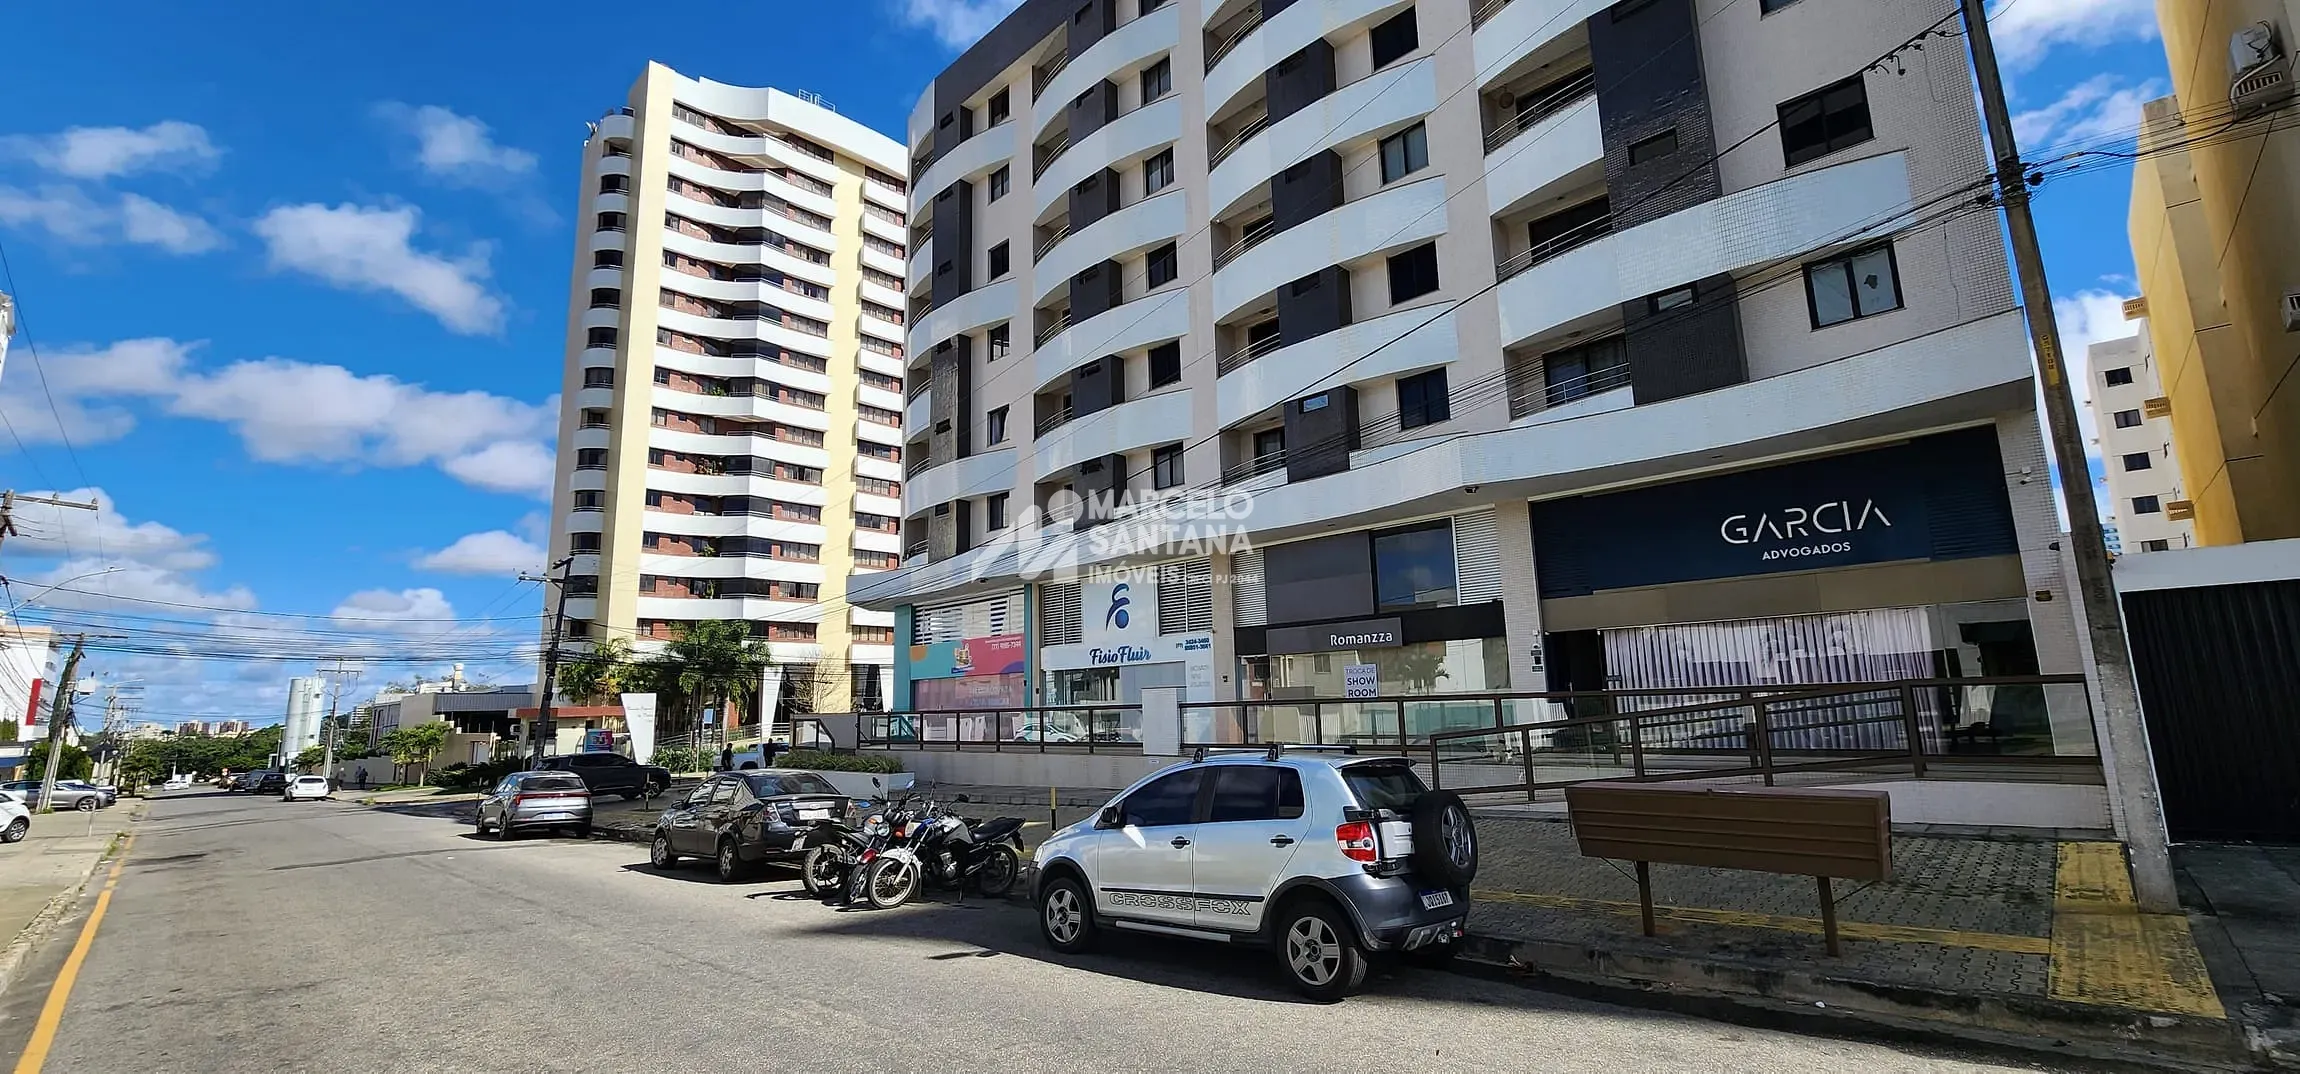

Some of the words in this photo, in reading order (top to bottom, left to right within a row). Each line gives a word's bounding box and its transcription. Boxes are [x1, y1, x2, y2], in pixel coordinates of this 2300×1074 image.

[1720, 499, 1892, 544] GARCIA
[1762, 542, 1851, 561] ADVOGADOS
[1330, 632, 1393, 646] Romanzza
[1347, 676, 1375, 686] SHOW
[1348, 688, 1377, 697] ROOM
[1108, 892, 1251, 916] CROSSFOX
